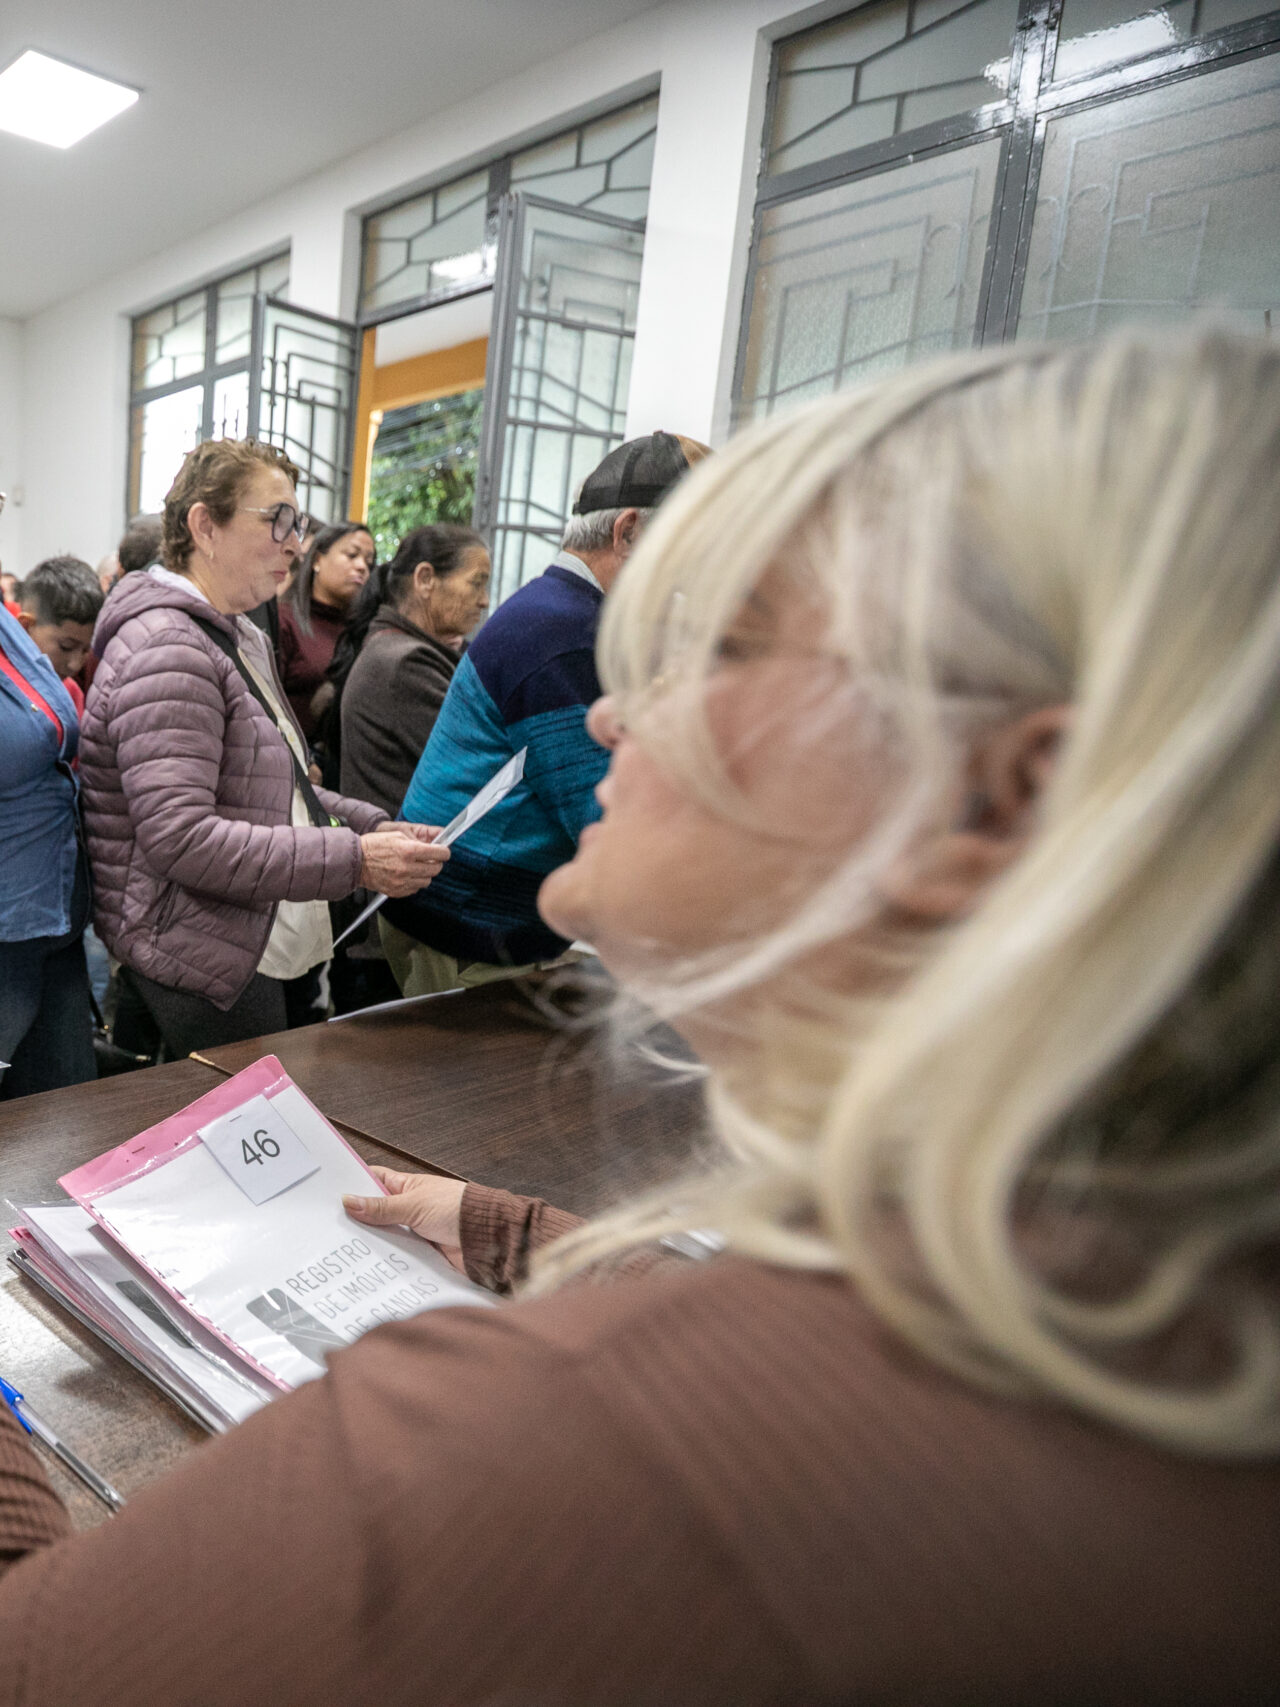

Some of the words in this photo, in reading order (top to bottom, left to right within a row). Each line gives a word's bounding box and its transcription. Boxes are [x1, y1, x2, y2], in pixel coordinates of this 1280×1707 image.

[241, 1129, 280, 1165] 46
[285, 1238, 372, 1296] REGISTRO
[313, 1293, 349, 1320] DE
[337, 1253, 410, 1304] IMÓVEIS
[371, 1277, 440, 1327] CANOAS
